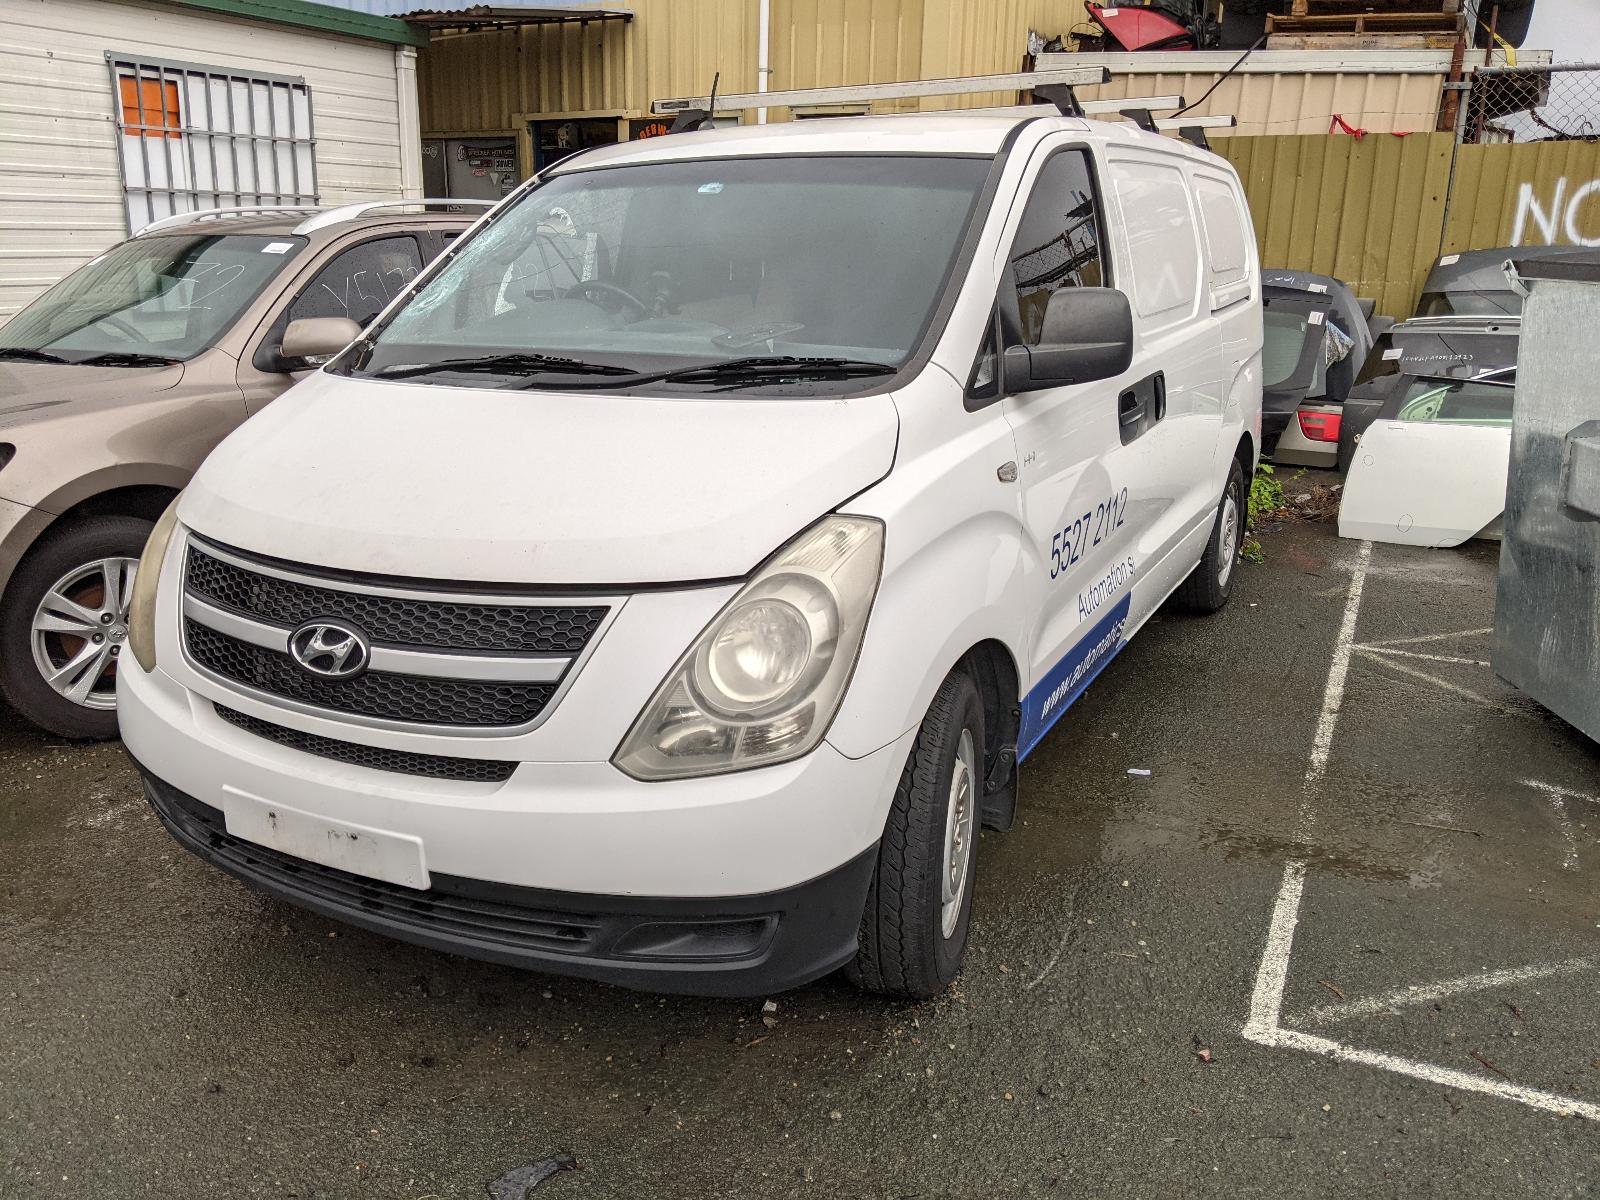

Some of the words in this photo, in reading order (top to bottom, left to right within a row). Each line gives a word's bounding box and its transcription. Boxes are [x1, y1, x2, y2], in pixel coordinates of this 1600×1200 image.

[1050, 511, 1092, 580] 5527
[1093, 486, 1128, 547] 2112
[1078, 560, 1128, 623] Automation
